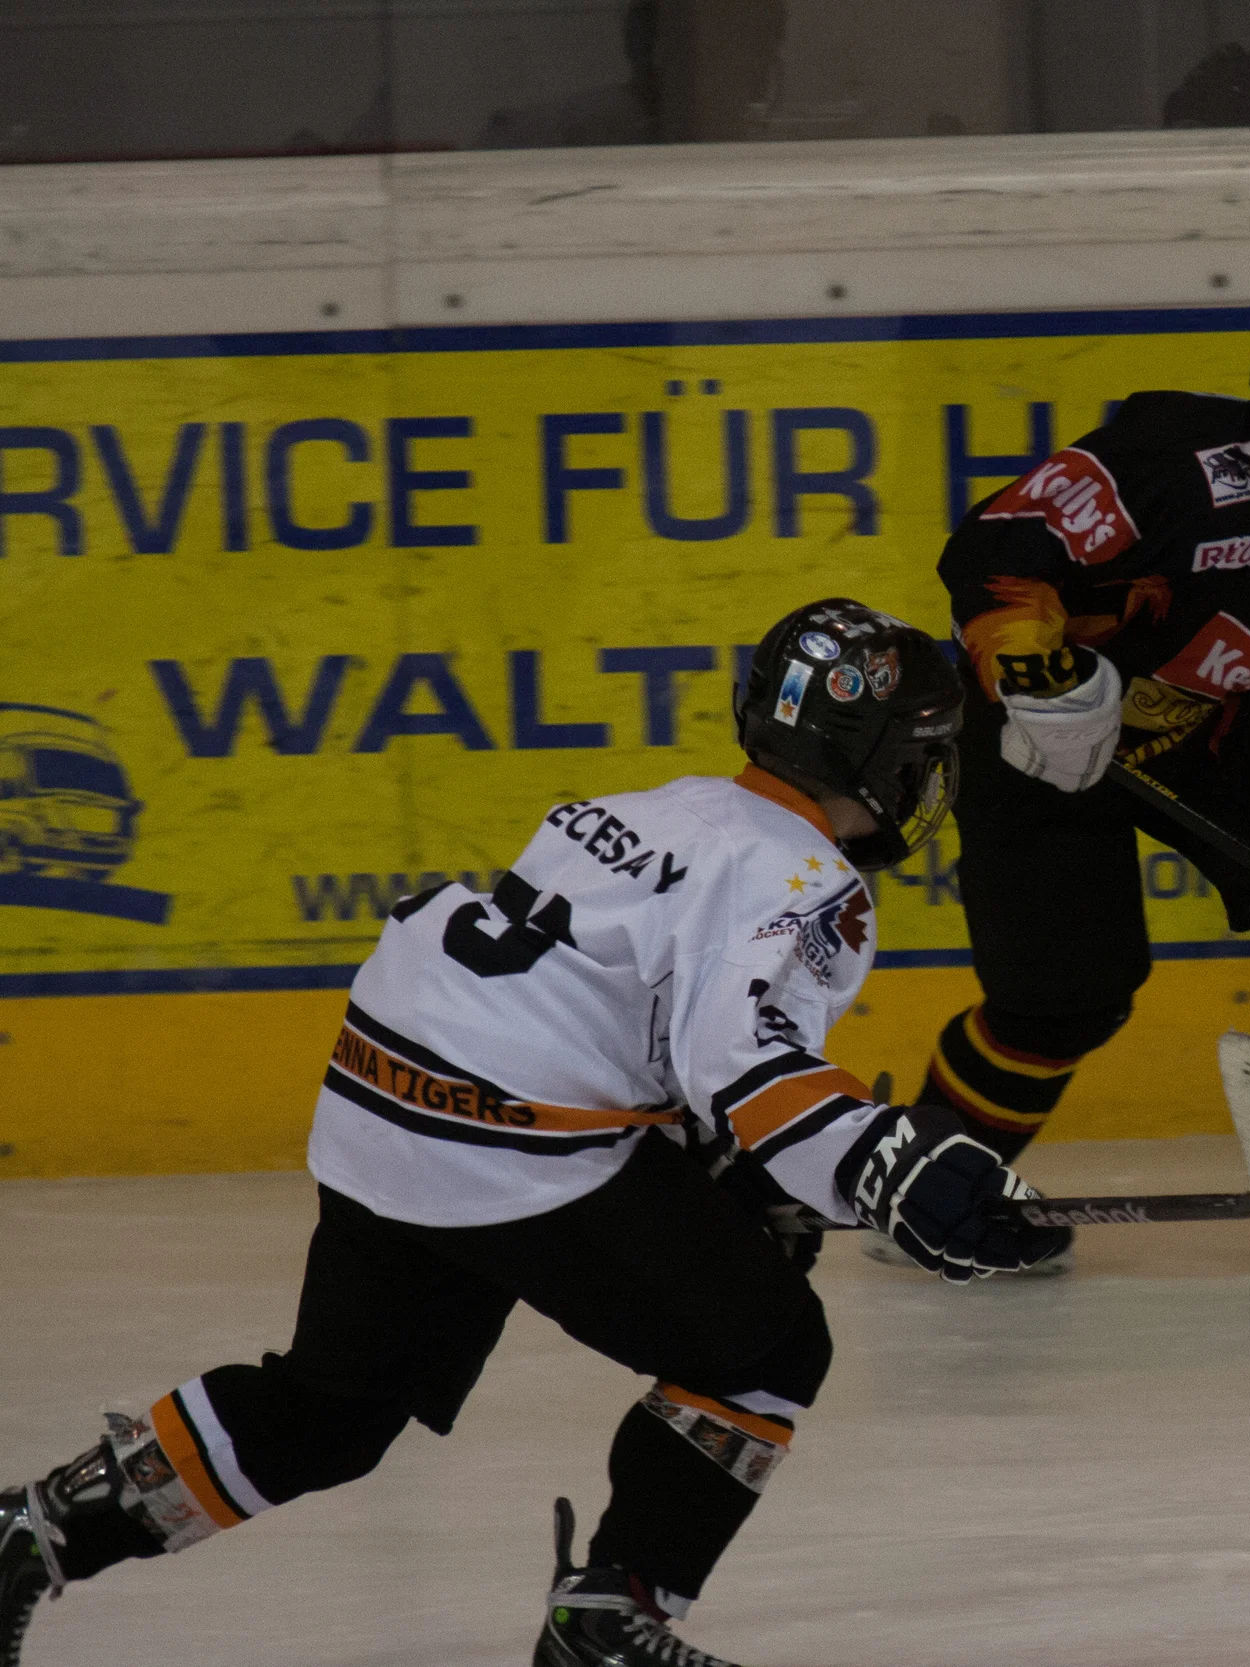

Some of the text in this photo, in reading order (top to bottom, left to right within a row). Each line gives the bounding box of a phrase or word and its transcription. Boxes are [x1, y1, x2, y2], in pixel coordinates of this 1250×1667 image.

[0, 416, 481, 558] RVICE
[539, 378, 883, 545] FÜR
[148, 639, 957, 760] WALT
[387, 1057, 536, 1126] TIGERS
[853, 1114, 917, 1231] CCM
